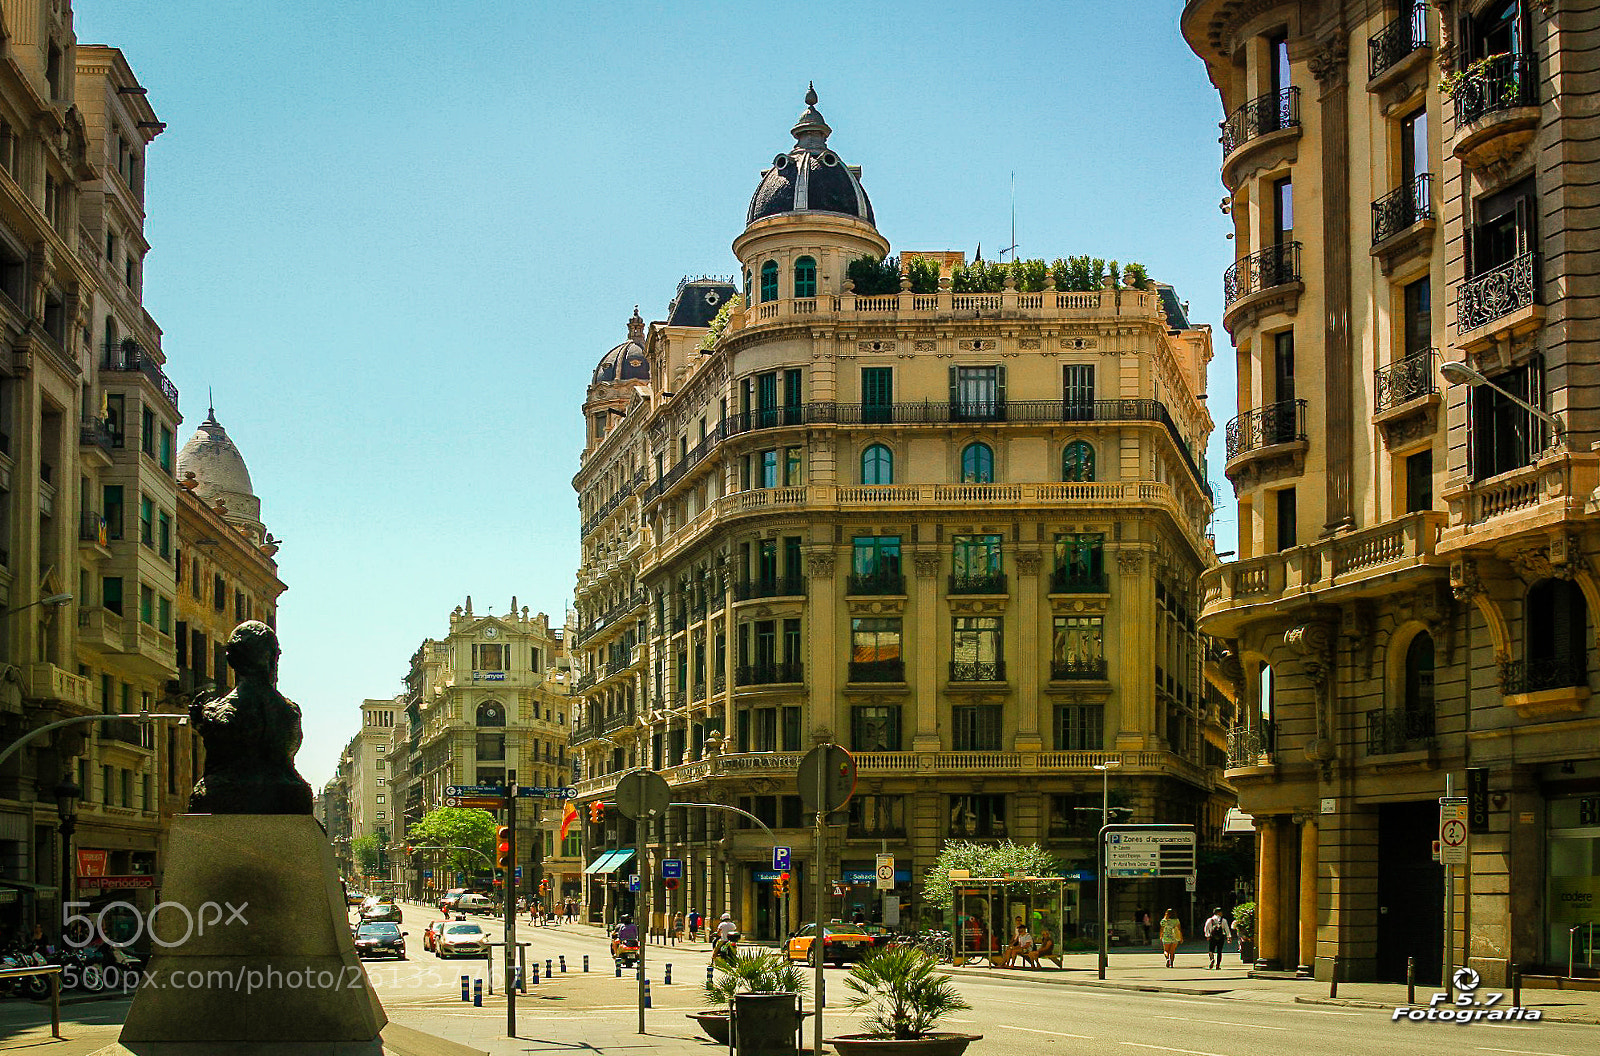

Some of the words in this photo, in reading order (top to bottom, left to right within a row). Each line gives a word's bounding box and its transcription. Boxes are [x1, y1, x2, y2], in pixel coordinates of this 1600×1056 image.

[1474, 772, 1484, 824] BINGO
[1449, 828, 1455, 838] 2
[777, 849, 788, 861] P
[90, 878, 100, 888] el
[102, 877, 153, 888] Periódico
[632, 876, 640, 886] P
[1561, 891, 1593, 902] codere
